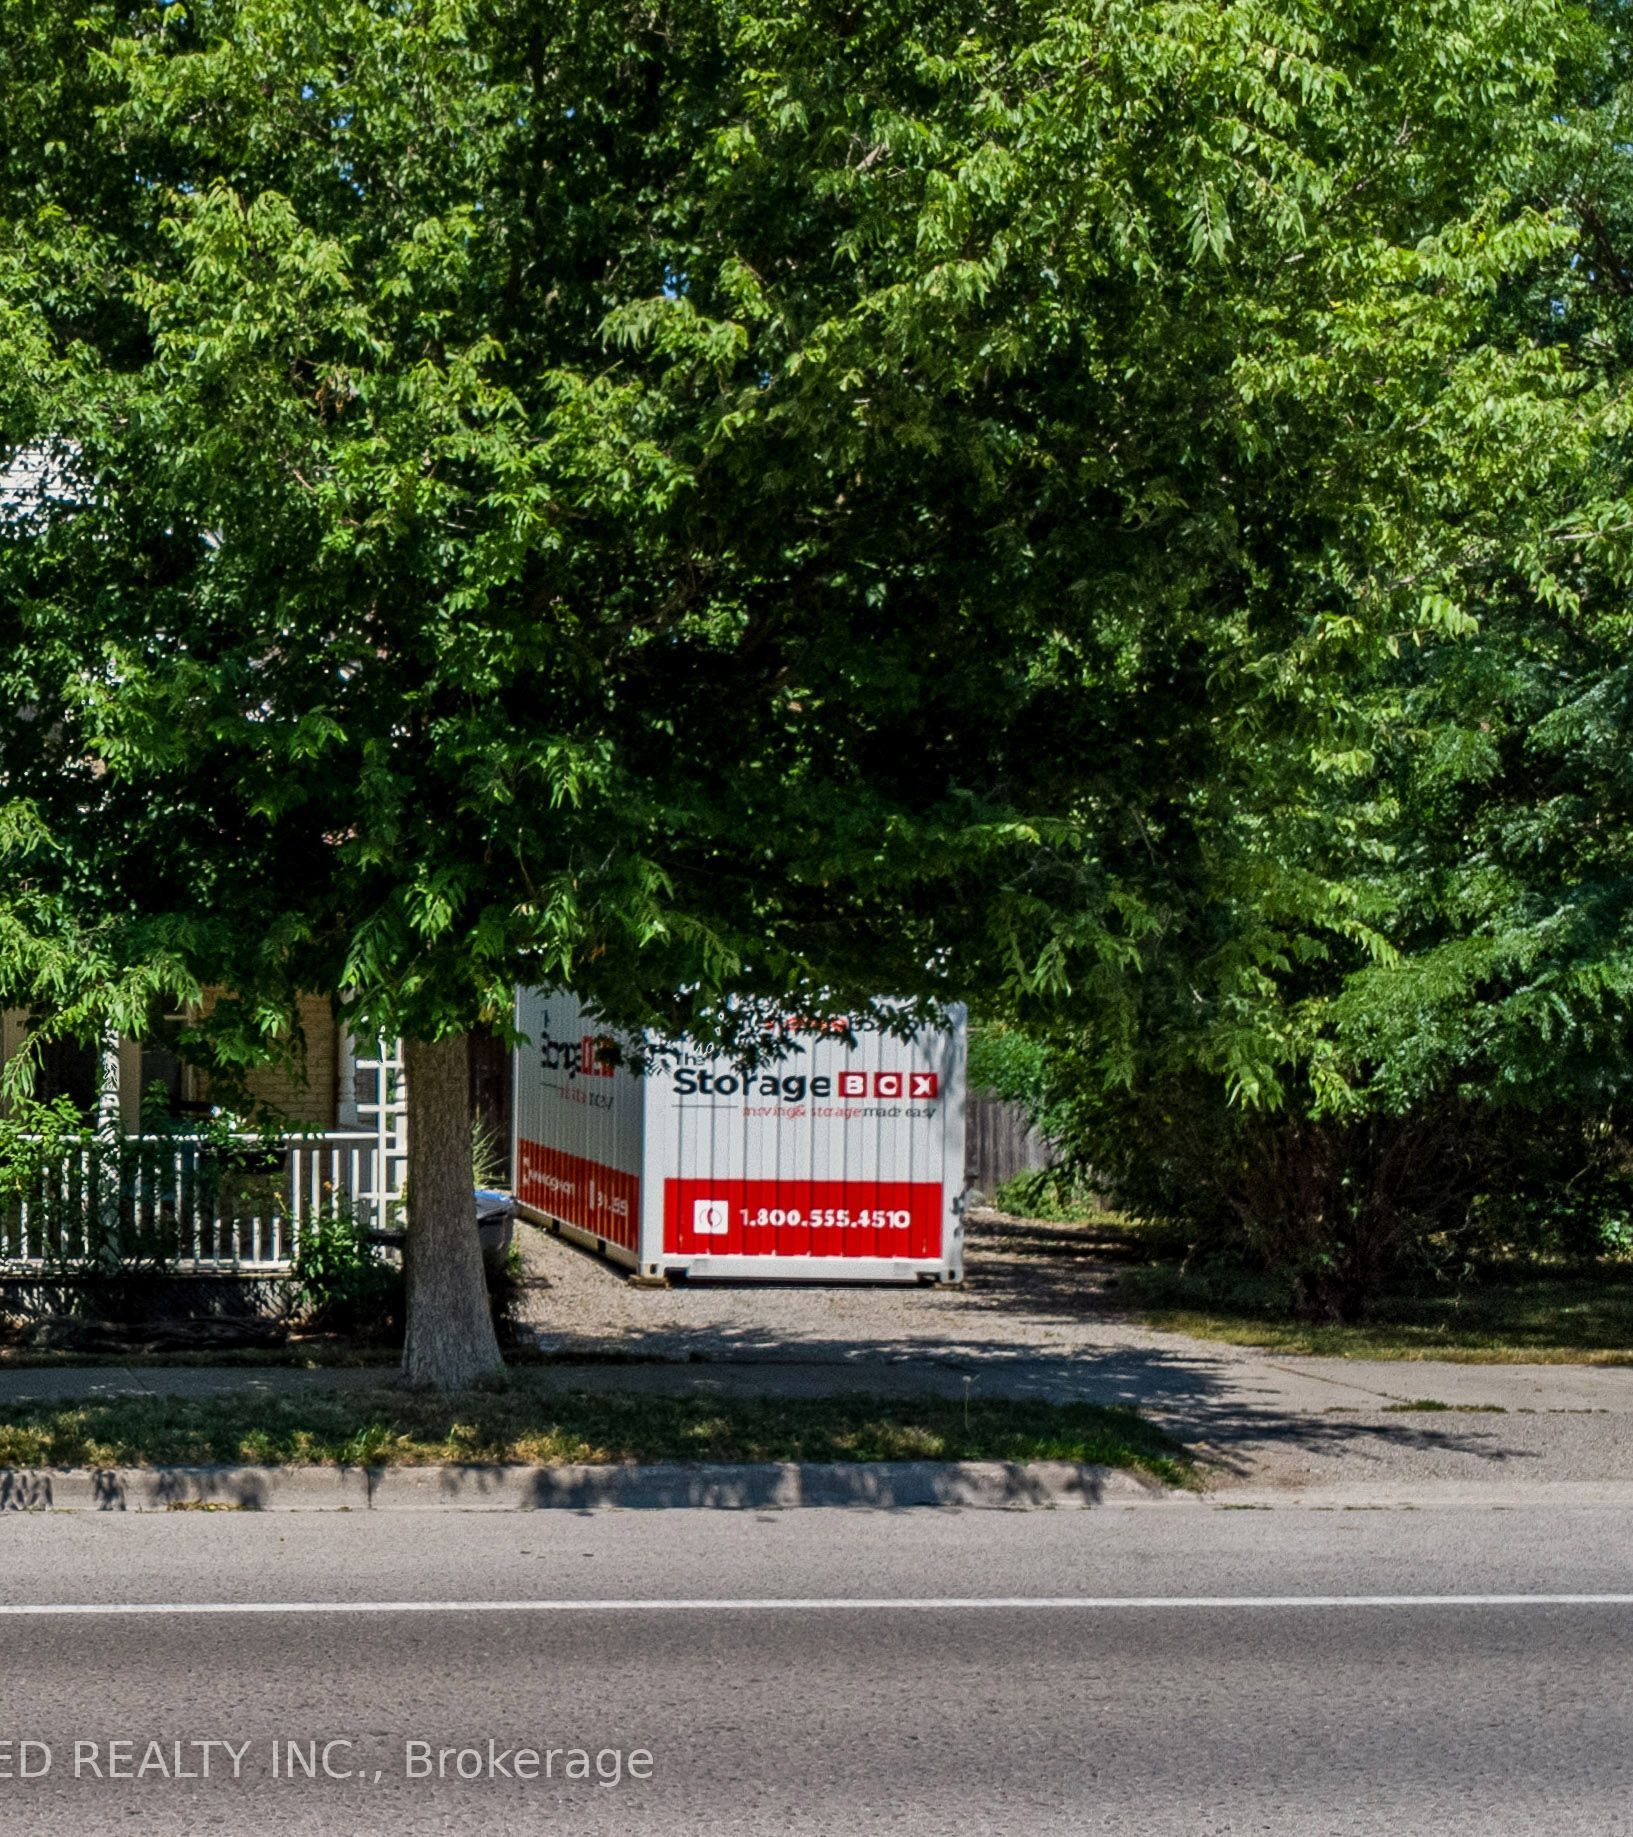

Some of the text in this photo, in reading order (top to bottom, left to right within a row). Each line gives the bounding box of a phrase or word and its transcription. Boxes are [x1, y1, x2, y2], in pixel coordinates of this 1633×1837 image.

[673, 1068, 935, 1102] Storage BOX
[740, 1208, 911, 1229] 1.800.555.4510
